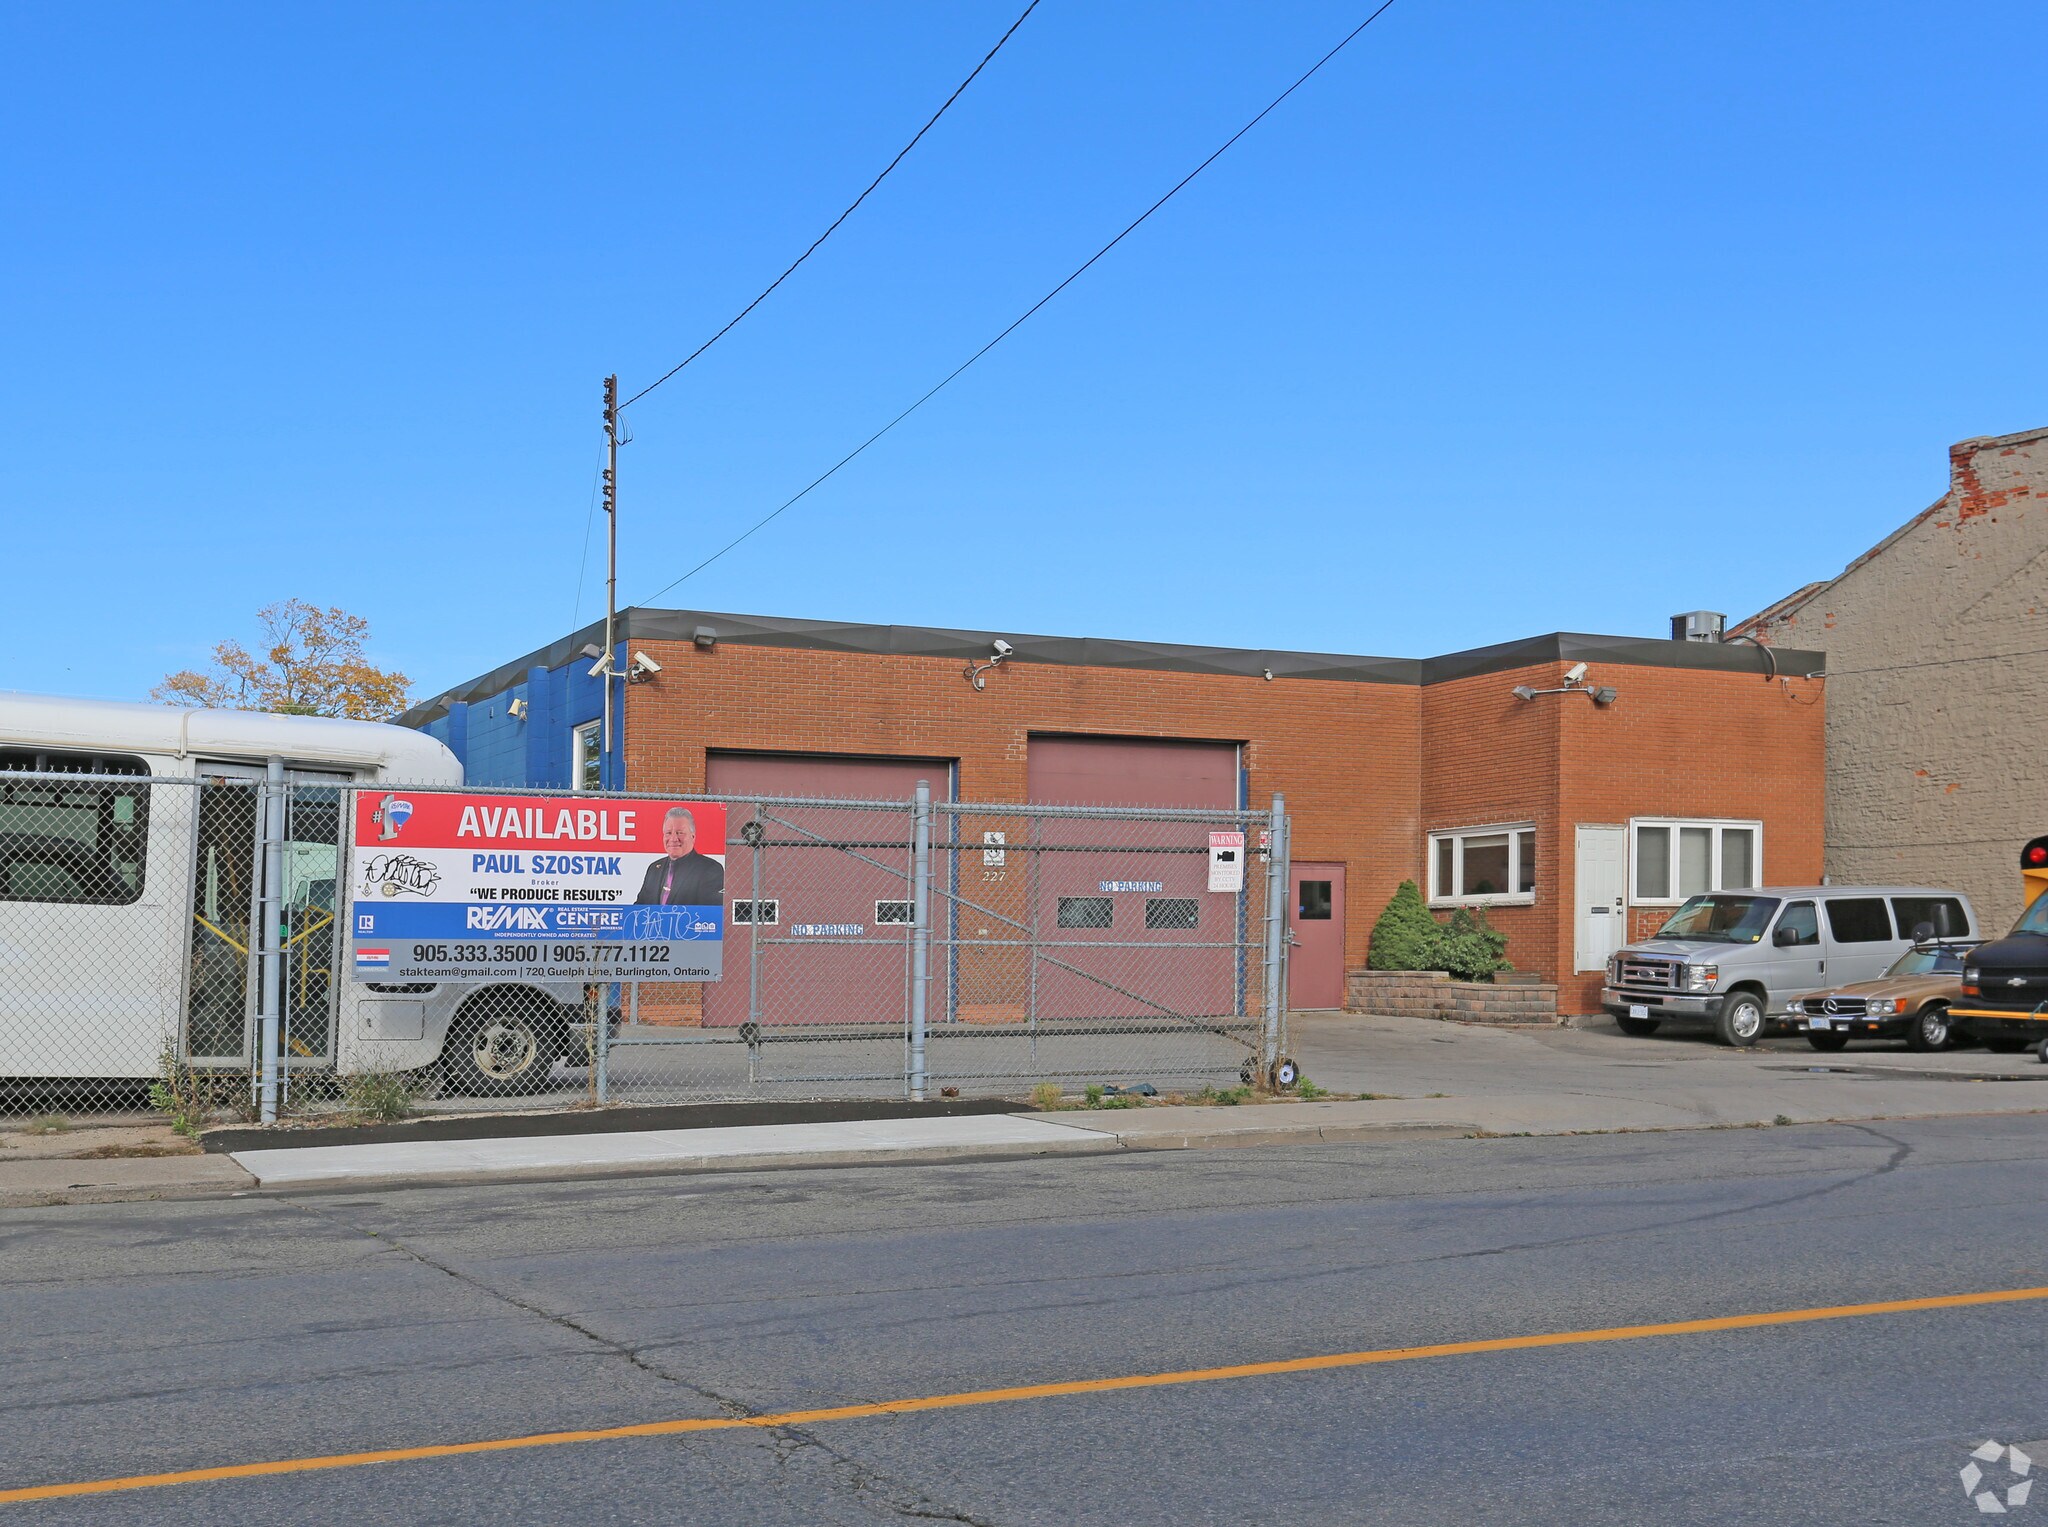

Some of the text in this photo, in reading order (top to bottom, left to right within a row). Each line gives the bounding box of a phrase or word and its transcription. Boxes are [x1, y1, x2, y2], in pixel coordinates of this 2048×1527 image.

[457, 805, 637, 842] AVAILABLE
[1210, 834, 1243, 845] WARNING
[472, 853, 622, 876] PAUL SZOSTAK
[982, 871, 1006, 882] 227
[1099, 881, 1163, 892] NO PARKING
[501, 888, 560, 901] PRODUCE
[466, 905, 549, 931] RE/MAX
[556, 912, 619, 926] CENTRE
[791, 924, 864, 936] NO PARKING
[413, 944, 538, 963] 905.333.3500
[553, 945, 670, 963] 905.777.1122
[399, 967, 517, 979] stakteam@gmail.com
[526, 967, 545, 977] 720
[547, 967, 585, 979] Guelph
[587, 967, 612, 978] Line,
[615, 967, 671, 979] Burlington,
[674, 968, 710, 978] Ontario
